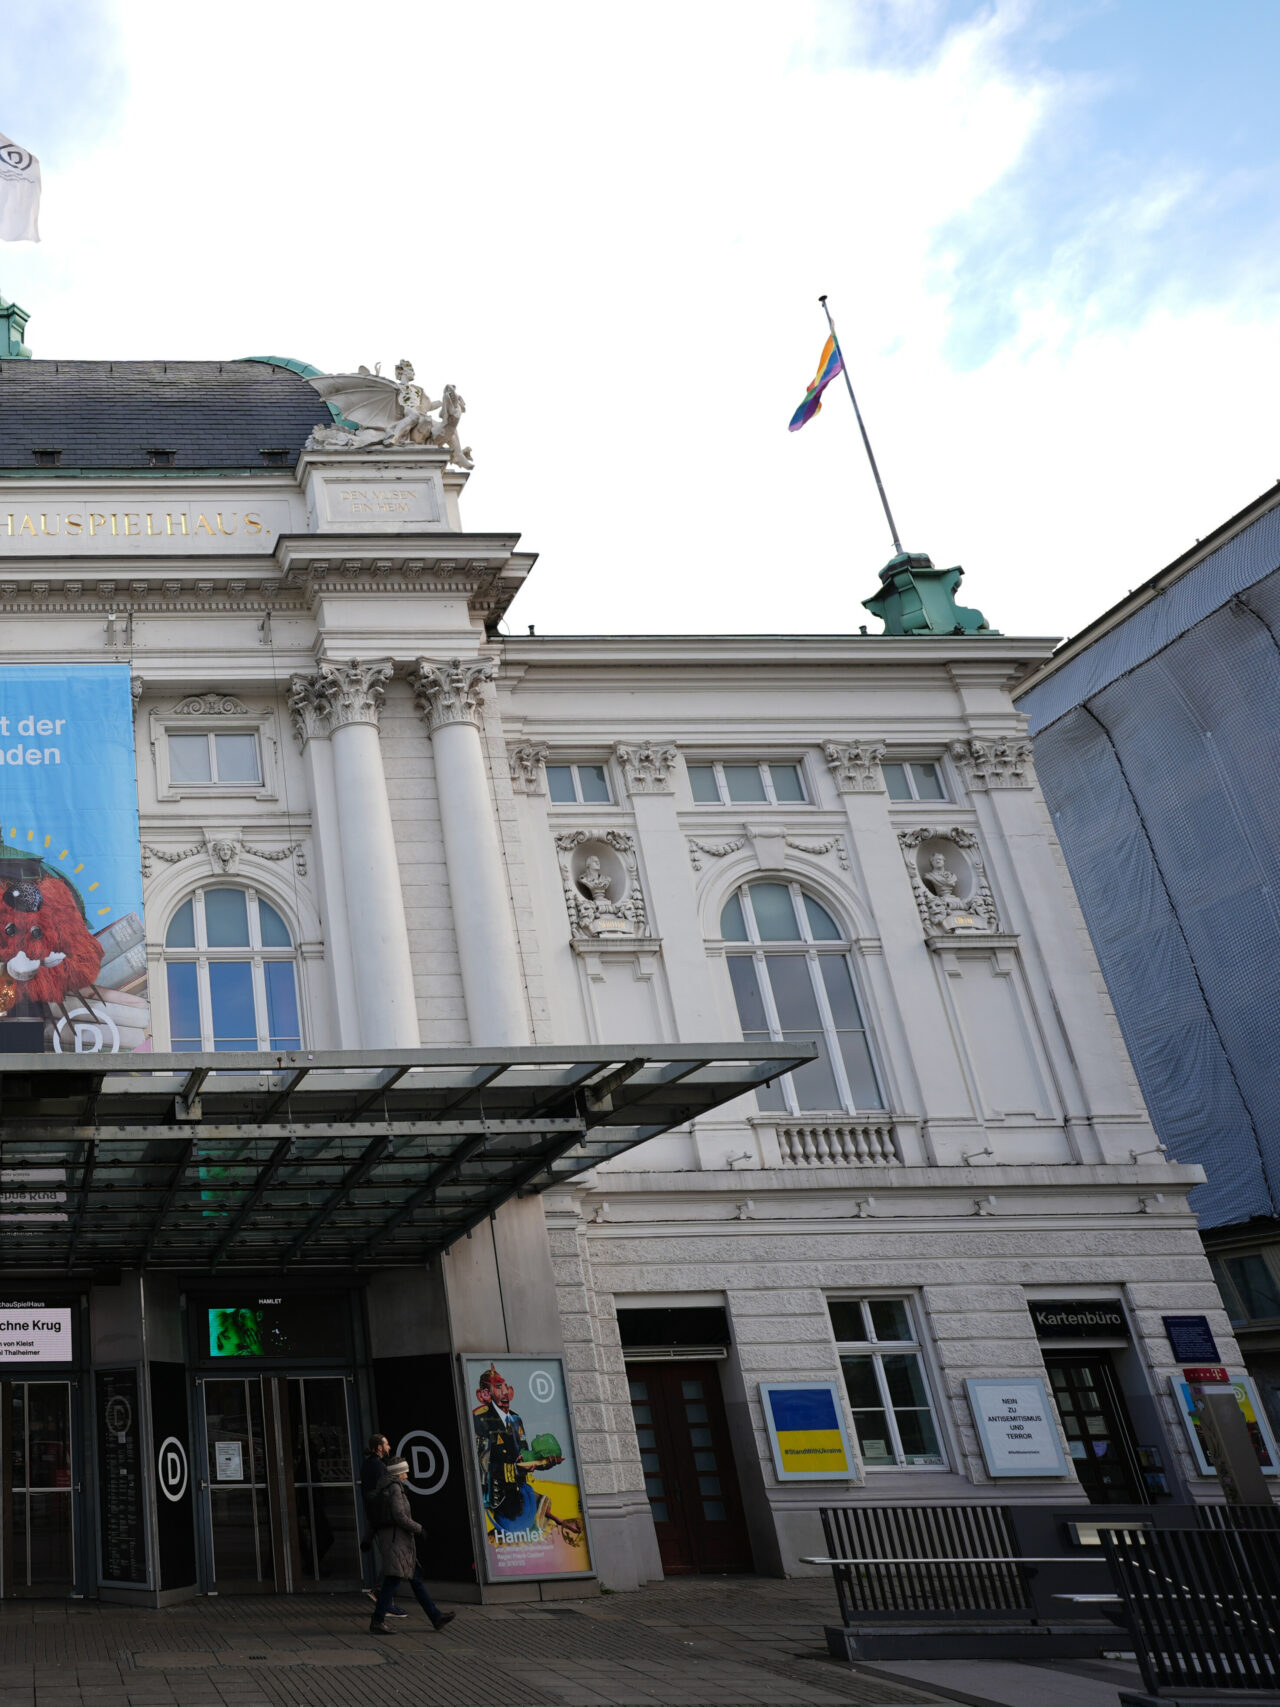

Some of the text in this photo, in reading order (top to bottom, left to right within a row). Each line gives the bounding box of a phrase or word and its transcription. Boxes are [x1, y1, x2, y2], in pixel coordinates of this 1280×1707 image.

[340, 490, 417, 500] DEN MUSEN
[352, 502, 410, 513] EIN HEIM
[17, 715, 66, 736] der
[1036, 1311, 1121, 1326] Kartenbüro
[32, 1320, 62, 1332] Krug
[494, 1527, 545, 1545] Hamlet
